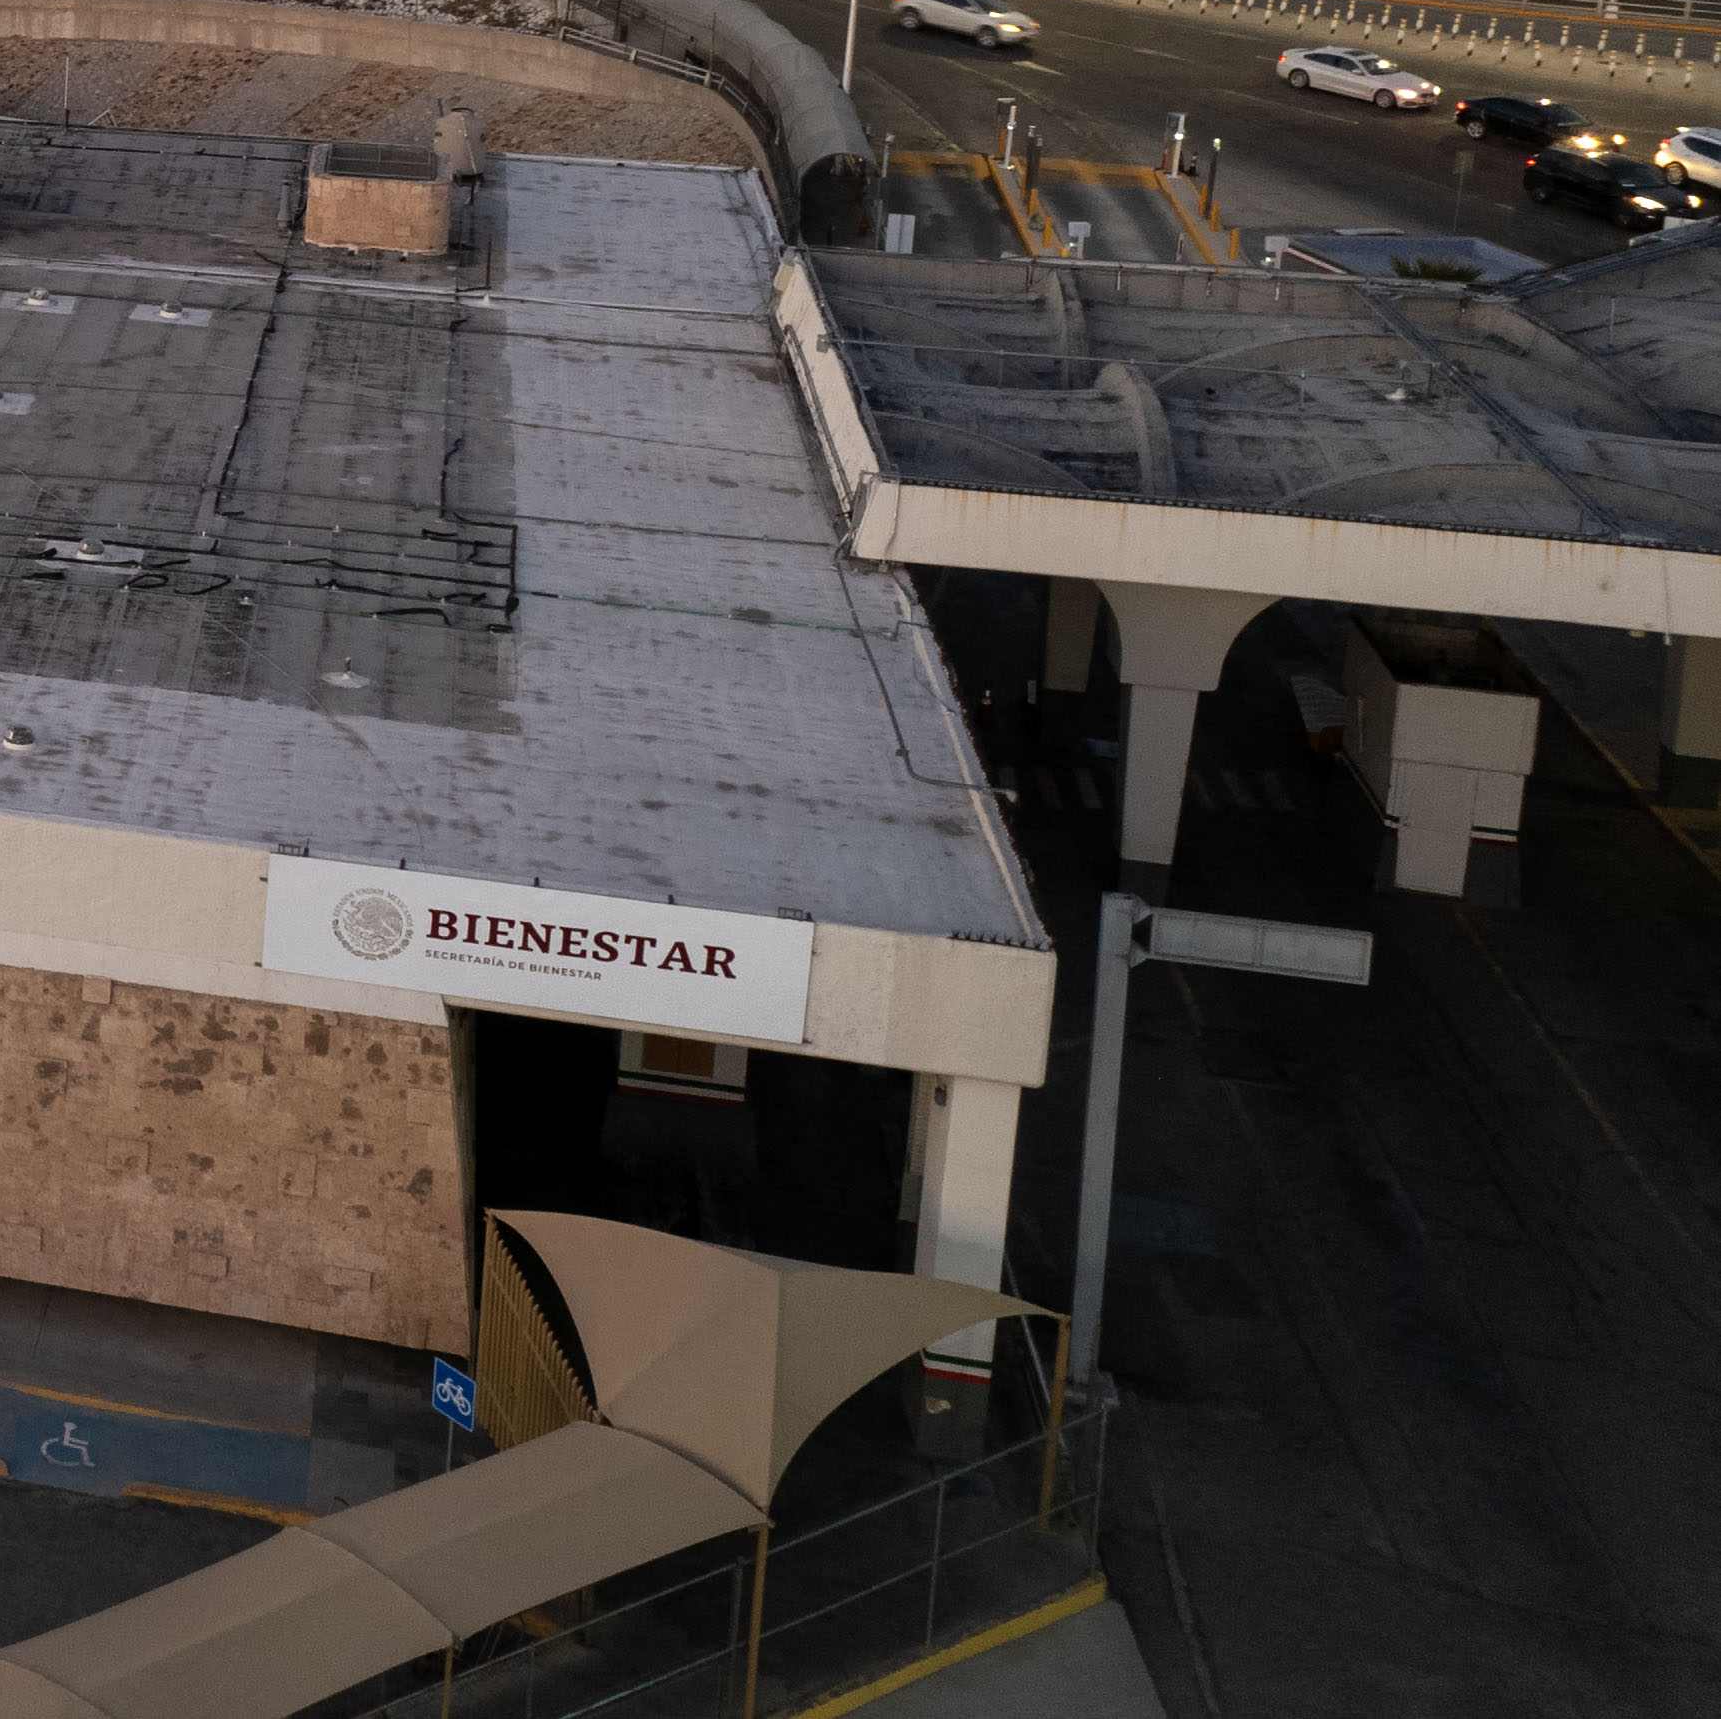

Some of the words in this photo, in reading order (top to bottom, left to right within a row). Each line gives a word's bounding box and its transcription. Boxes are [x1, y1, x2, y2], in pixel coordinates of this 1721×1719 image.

[425, 949, 505, 968] SECRETARÍA
[508, 960, 526, 971] DE
[529, 963, 602, 981] BIENESTAR
[426, 907, 737, 980] BIENESTAR
